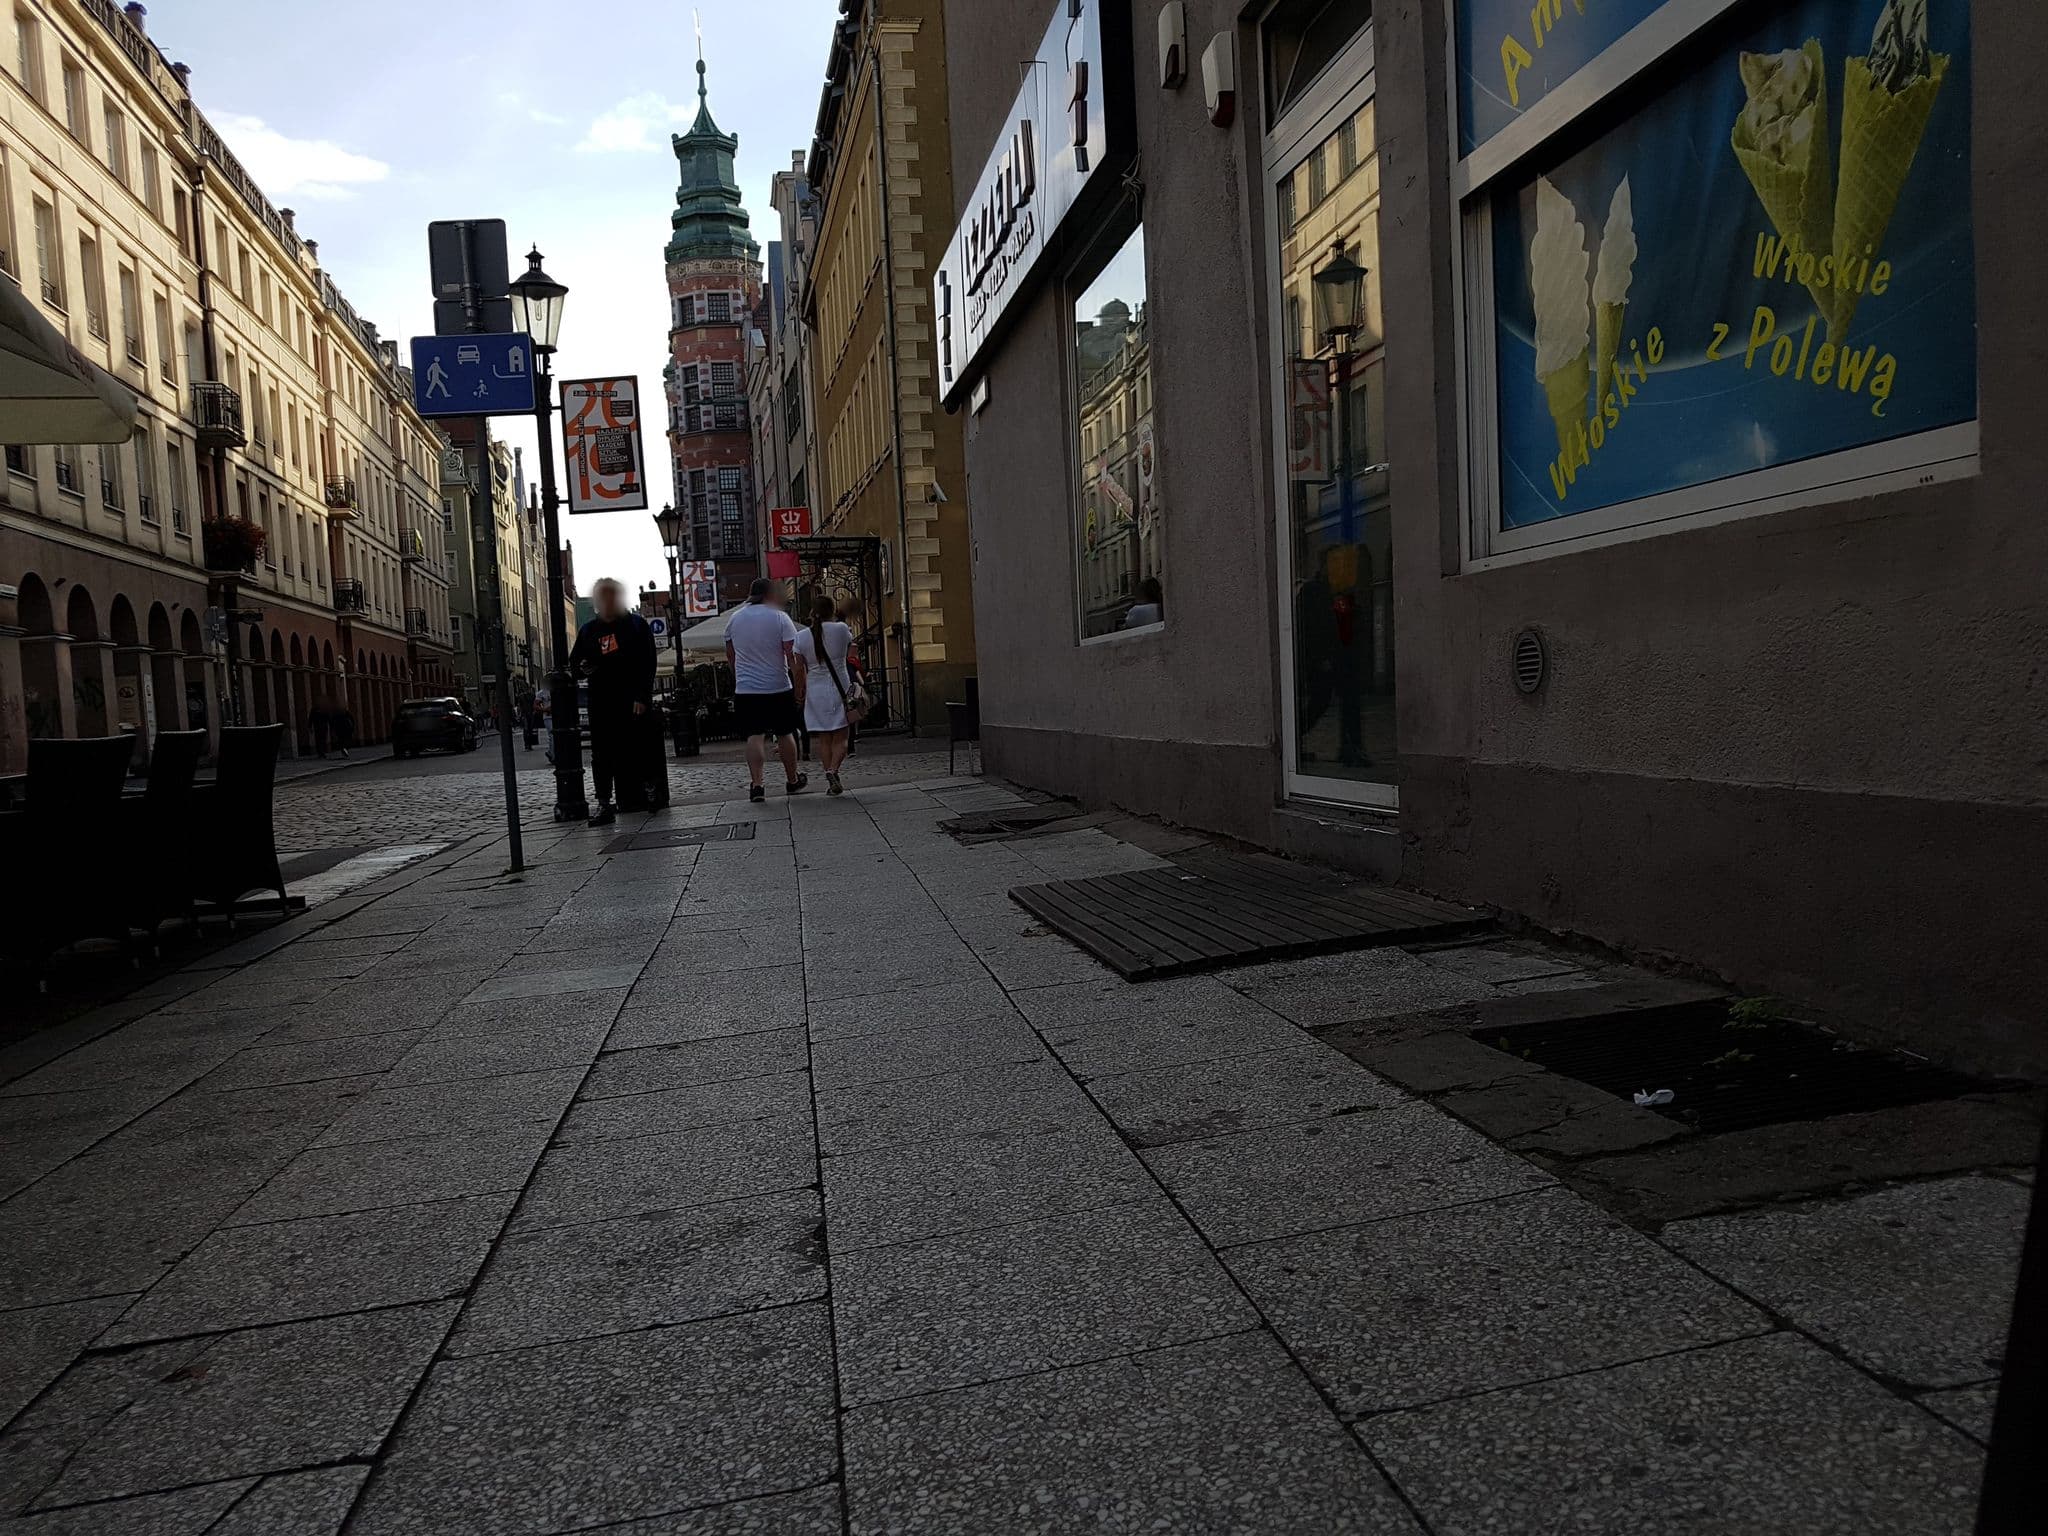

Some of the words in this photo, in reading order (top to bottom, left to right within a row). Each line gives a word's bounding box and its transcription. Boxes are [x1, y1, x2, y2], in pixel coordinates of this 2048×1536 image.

[1753, 232, 1893, 297] Włoskie
[1706, 320, 1729, 360] z
[1745, 305, 1898, 418] Polewą
[781, 524, 802, 535] SIX
